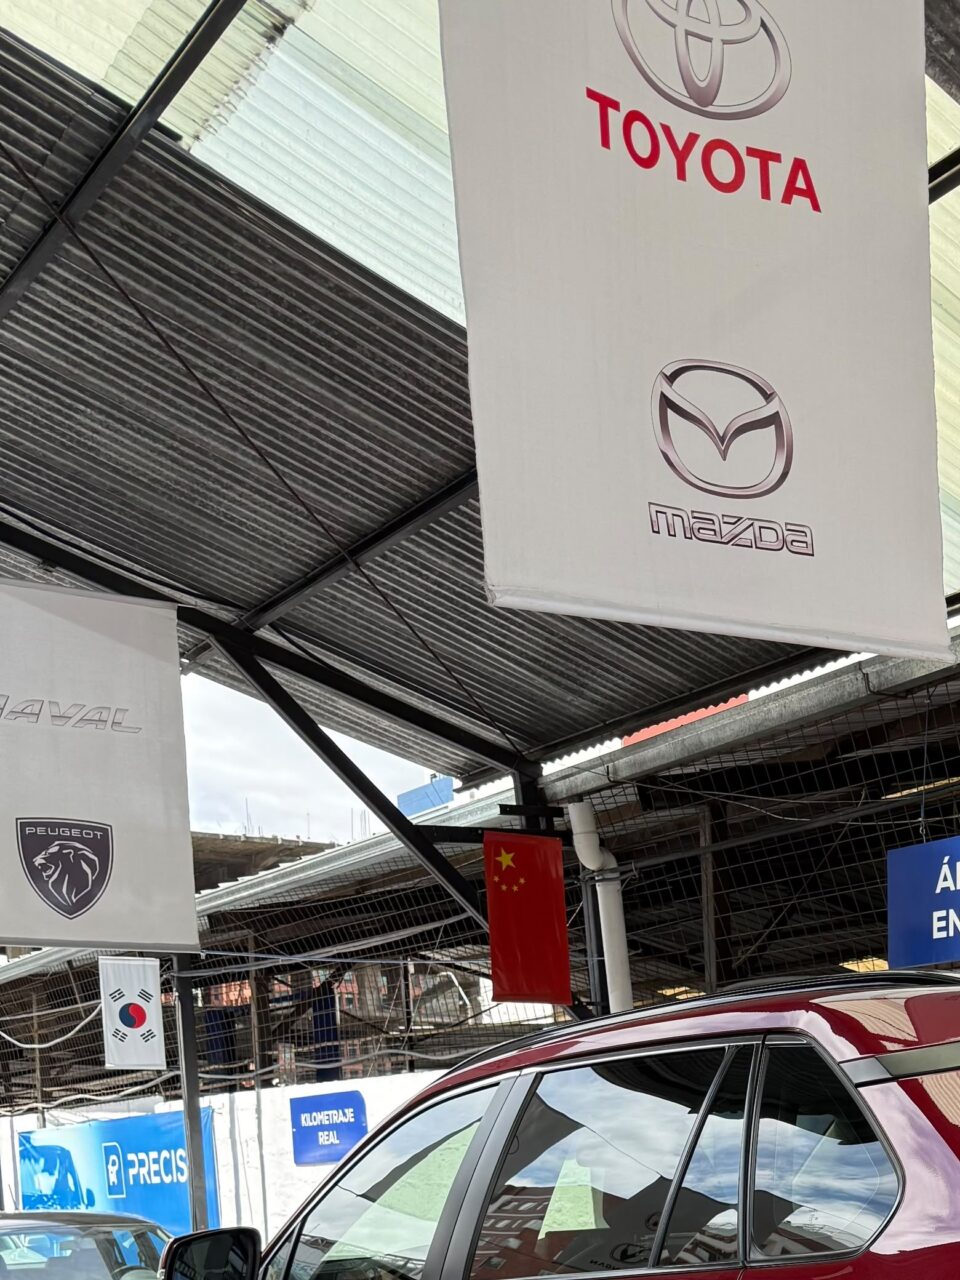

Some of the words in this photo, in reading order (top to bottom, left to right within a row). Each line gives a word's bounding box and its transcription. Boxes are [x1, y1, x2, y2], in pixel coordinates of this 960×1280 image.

[586, 86, 822, 213] TOYOTA
[25, 826, 104, 839] PEUGEOT
[300, 1108, 355, 1127] KILOMETRAJE
[318, 1130, 340, 1145] REAL
[127, 1148, 189, 1185] PRECIS
